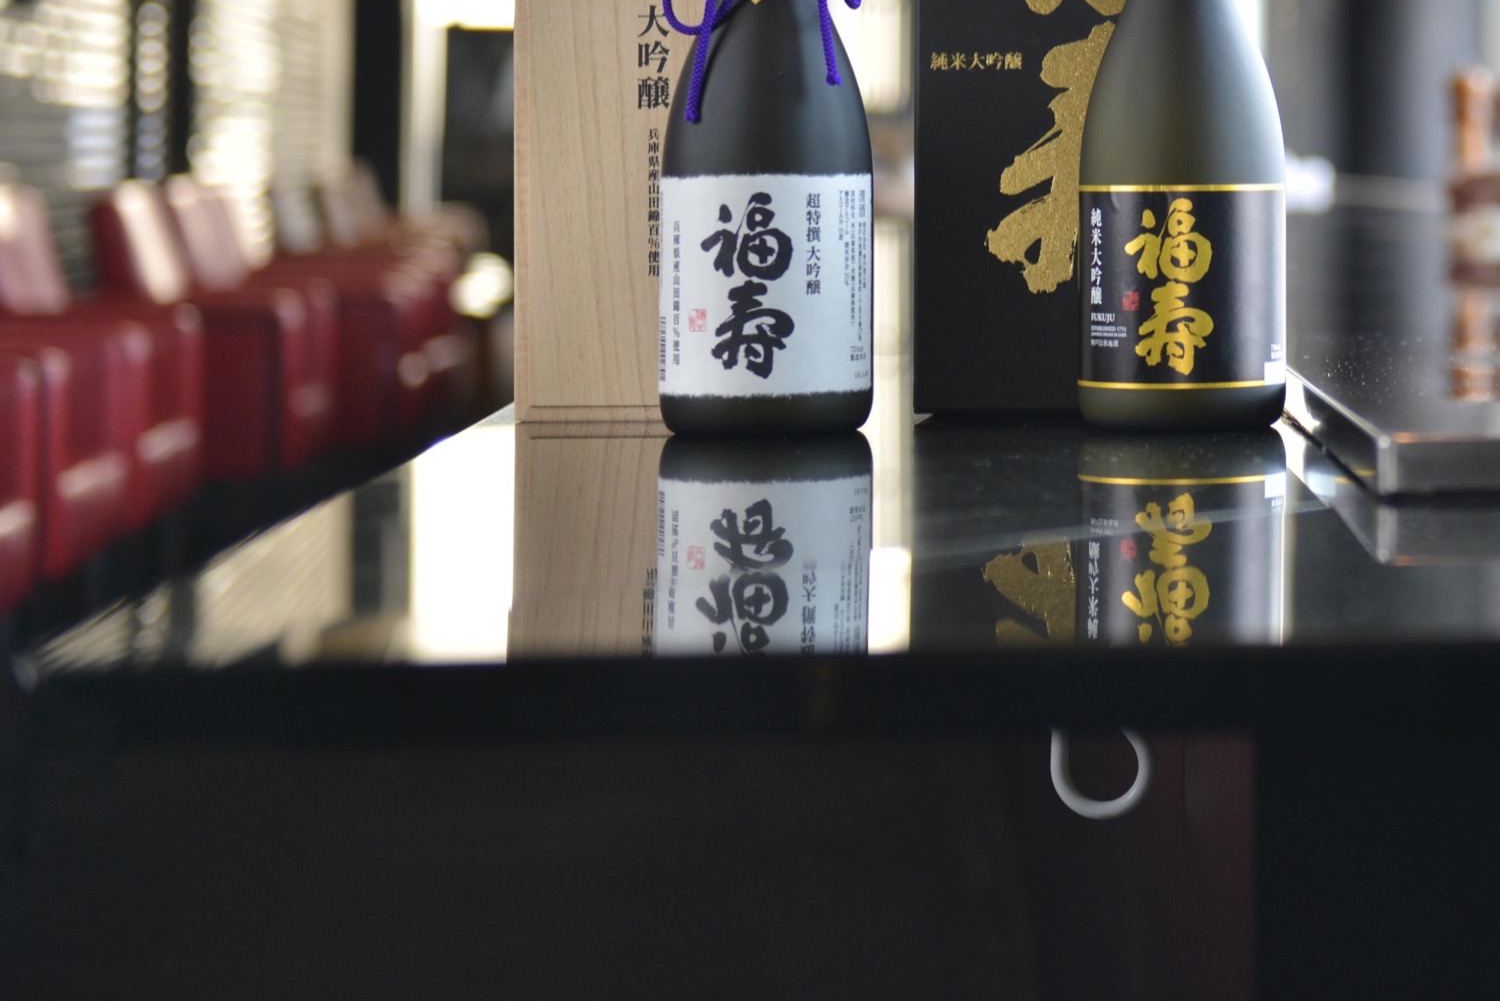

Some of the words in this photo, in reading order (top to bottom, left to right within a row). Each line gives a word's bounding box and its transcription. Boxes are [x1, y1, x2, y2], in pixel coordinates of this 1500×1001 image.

[930, 51, 1023, 71] 純米大吟醸
[700, 191, 795, 380] 福寿
[1090, 207, 1103, 306] 純米大吟醸
[1124, 197, 1214, 376] 福寿
